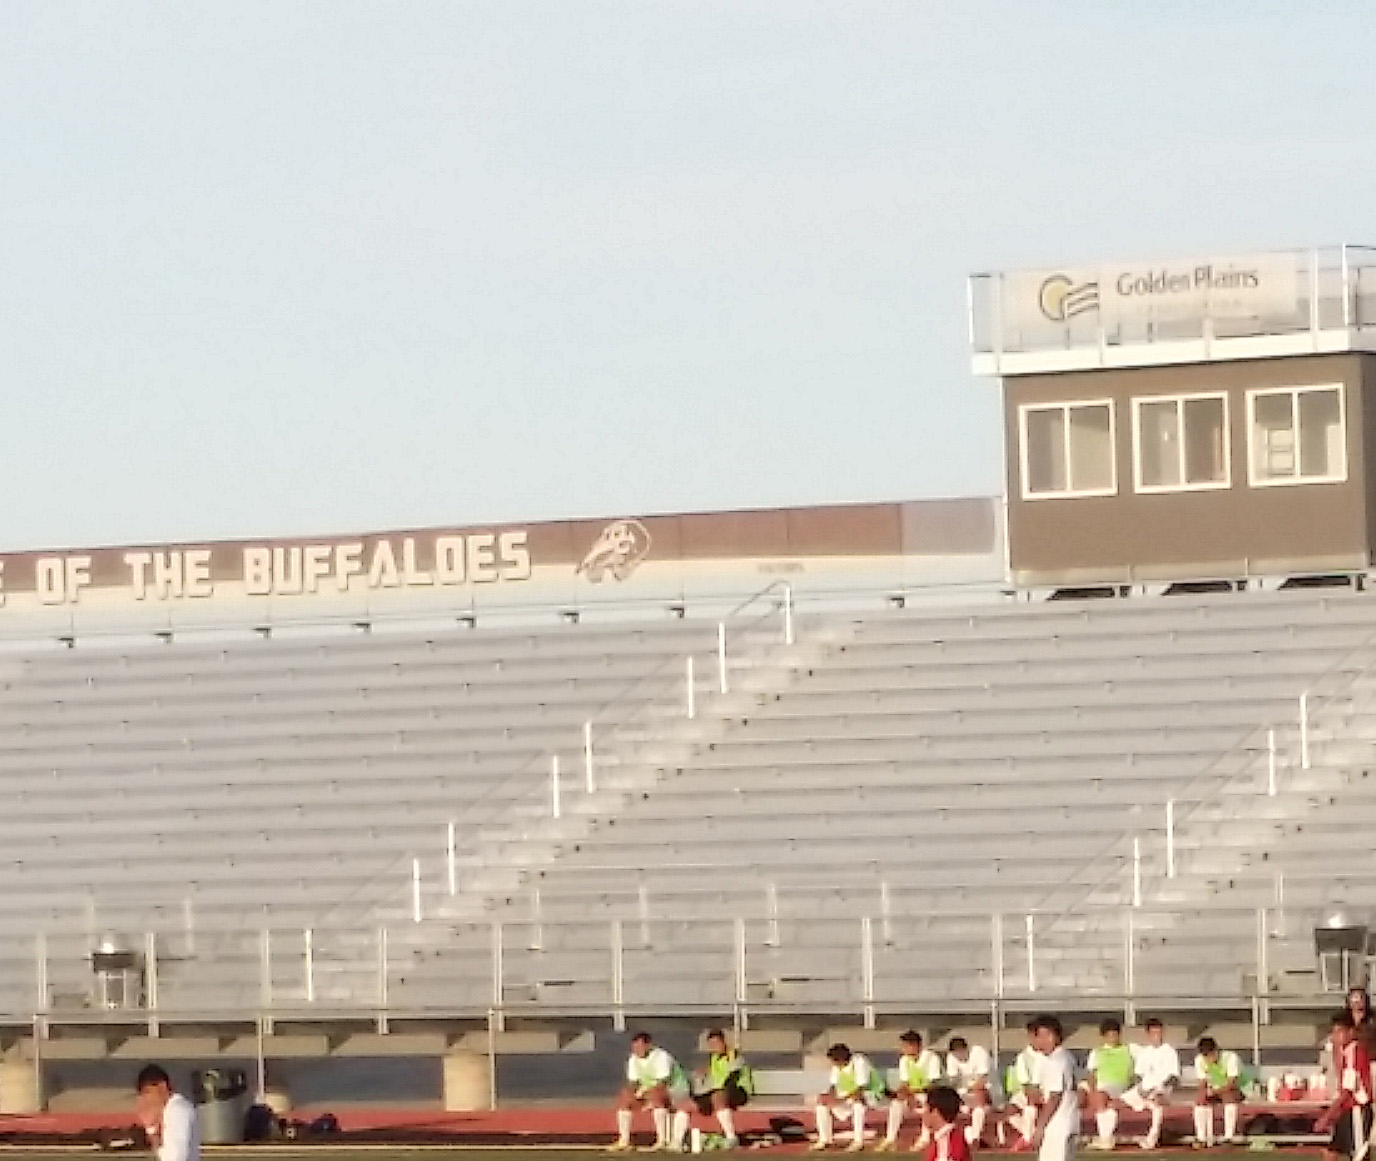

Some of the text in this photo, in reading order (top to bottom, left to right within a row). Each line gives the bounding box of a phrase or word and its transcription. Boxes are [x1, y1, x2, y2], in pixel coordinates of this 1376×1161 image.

[1117, 264, 1258, 296] Golden Plains
[35, 556, 92, 605] OF
[124, 549, 213, 602] THE
[243, 530, 530, 596] BUFFALOES
